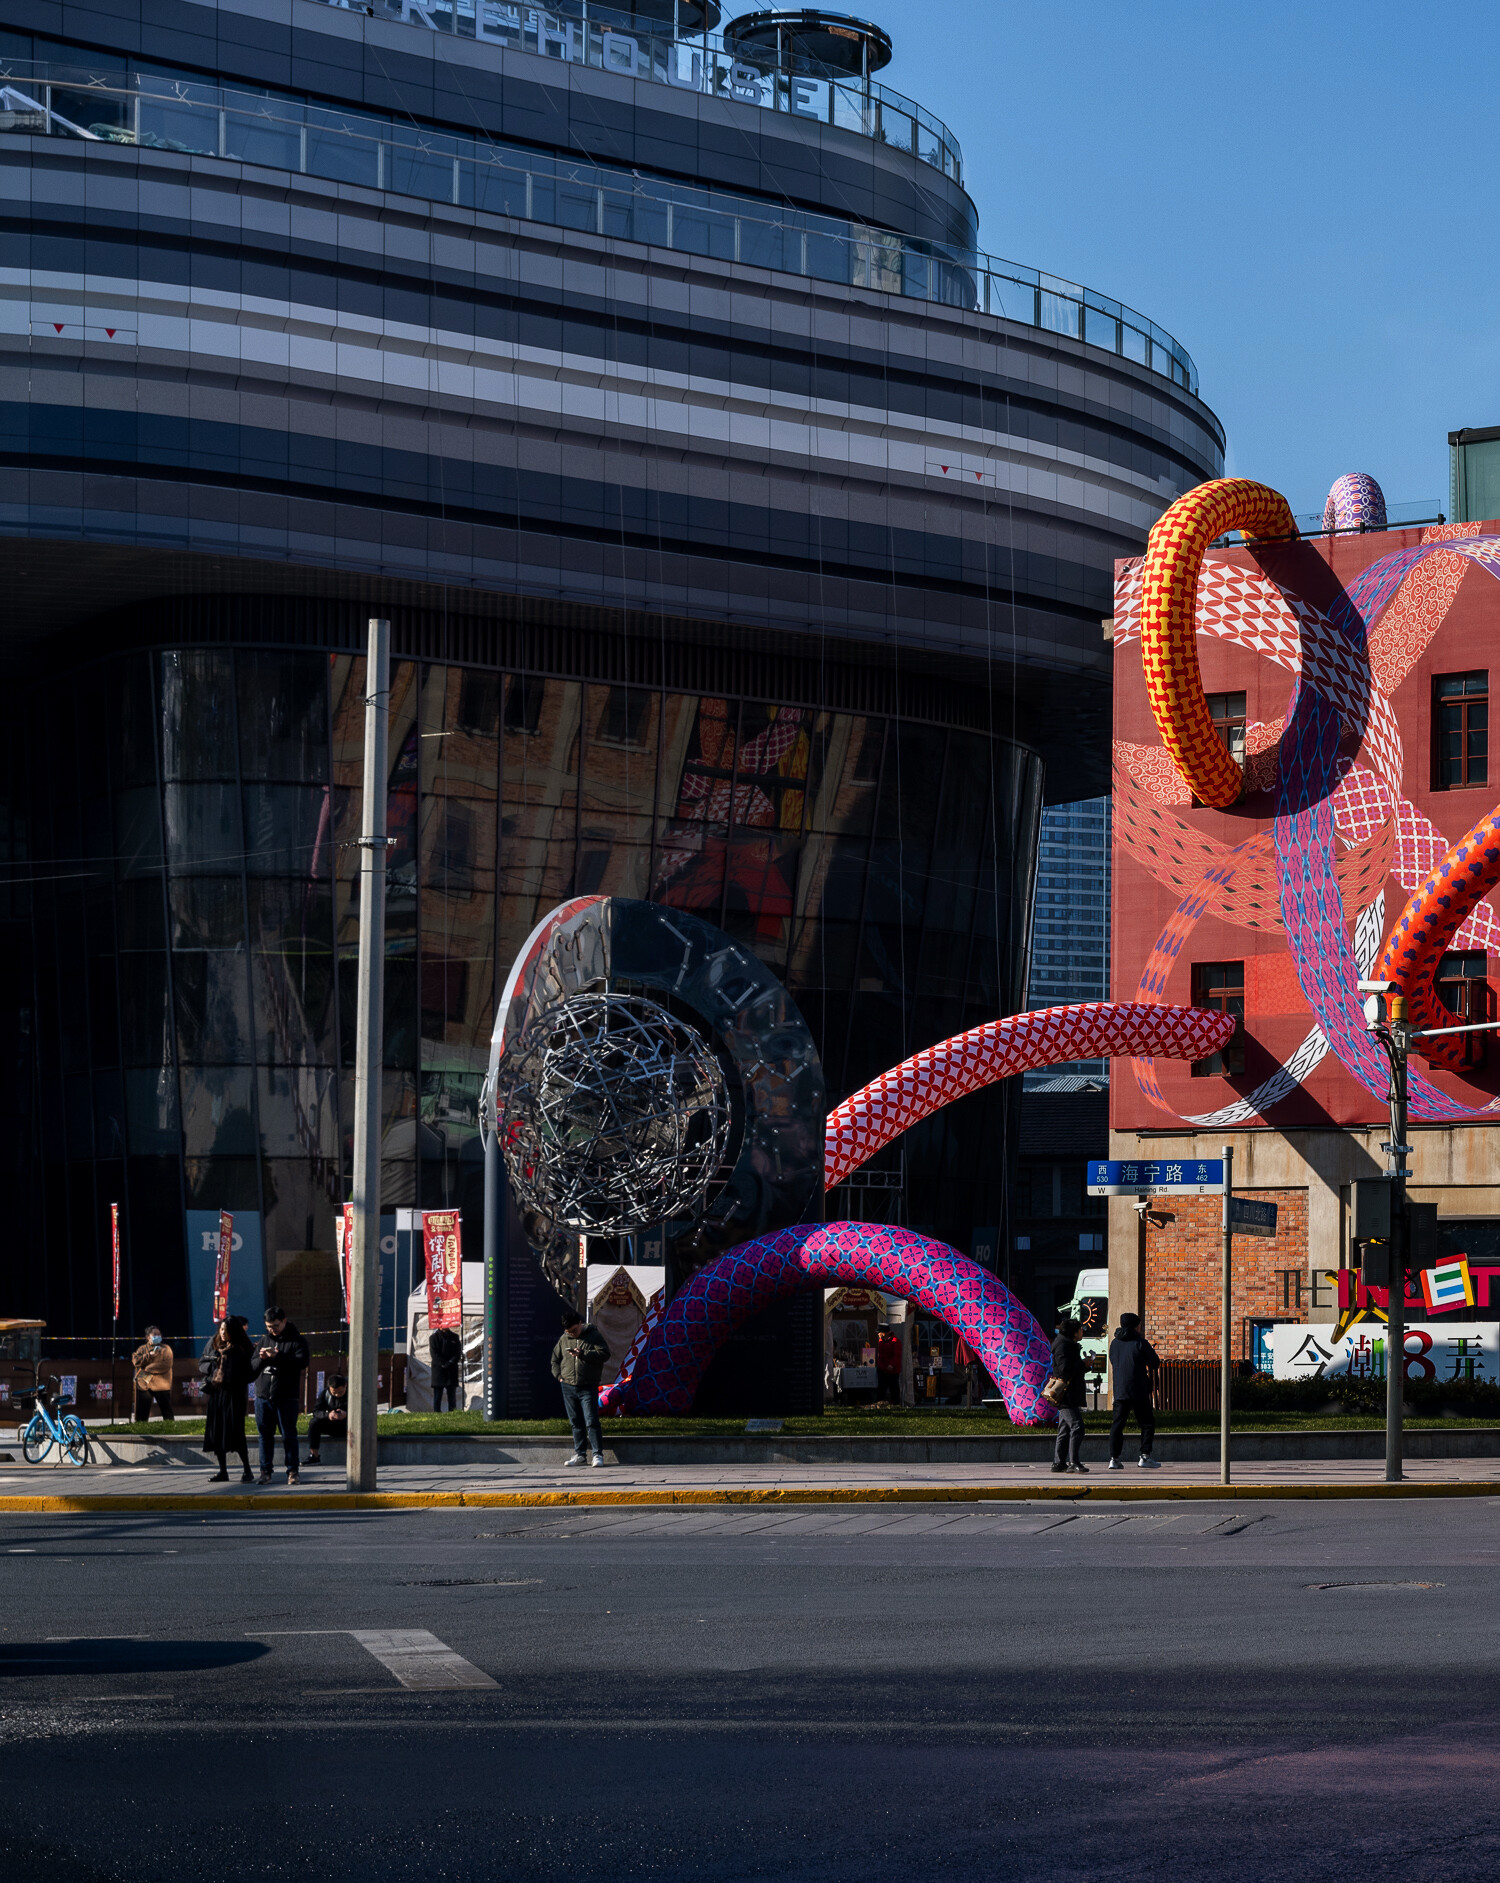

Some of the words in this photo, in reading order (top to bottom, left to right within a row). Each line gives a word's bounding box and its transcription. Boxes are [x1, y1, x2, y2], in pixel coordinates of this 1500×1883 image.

[328, 0, 818, 120] REHOUSE
[1097, 1164, 1108, 1175] 西
[1121, 1163, 1183, 1183] 海宁路
[1197, 1163, 1207, 1174] 东
[1096, 1175, 1109, 1183] 530
[1195, 1174, 1209, 1182] 462
[1134, 1186, 1157, 1194] Haining
[1274, 1269, 1333, 1308] THE
[1287, 1330, 1486, 1380] 今潮8弄
